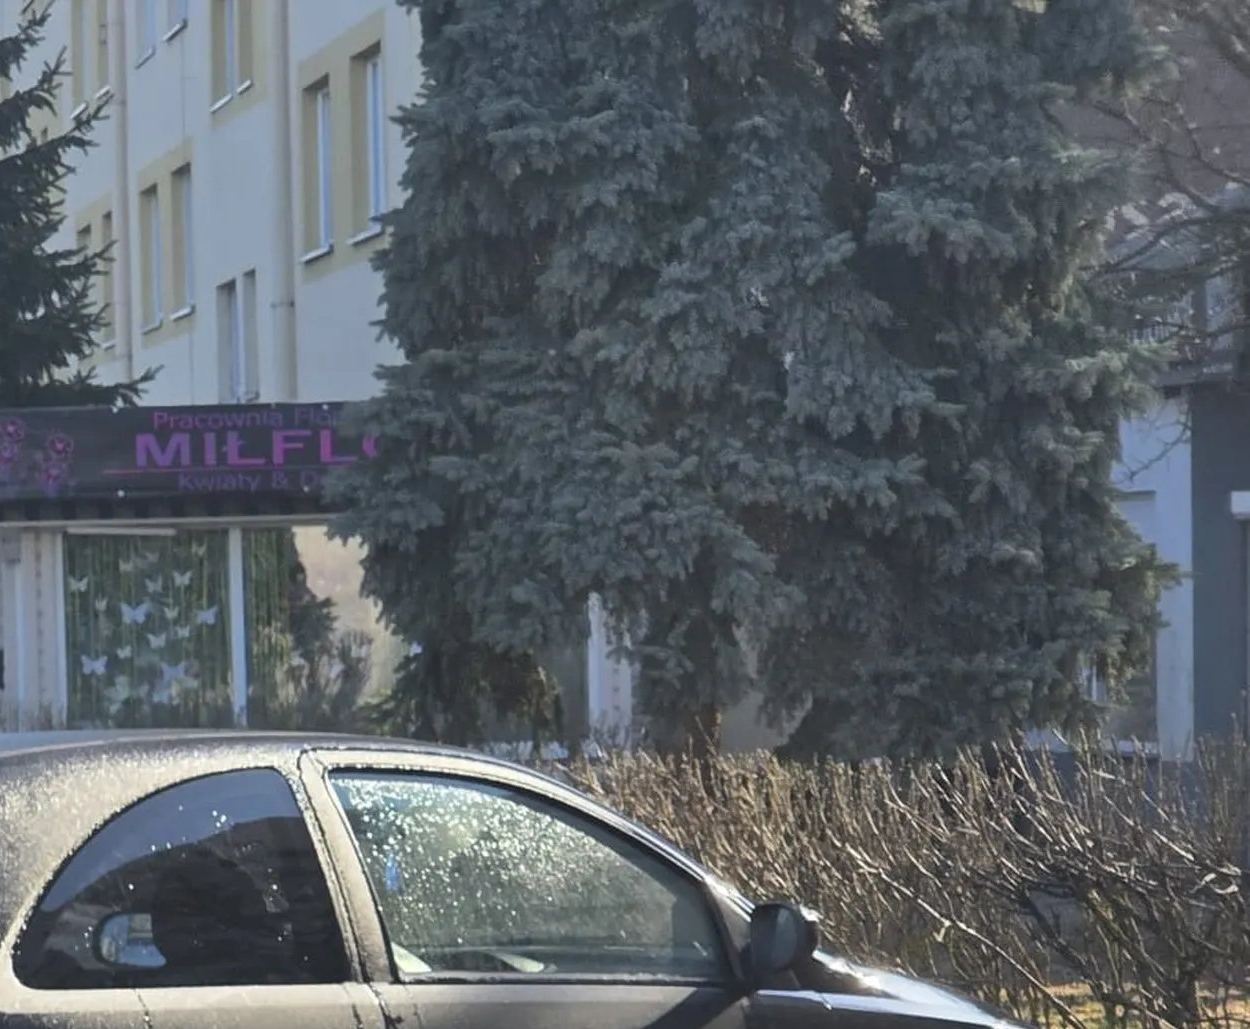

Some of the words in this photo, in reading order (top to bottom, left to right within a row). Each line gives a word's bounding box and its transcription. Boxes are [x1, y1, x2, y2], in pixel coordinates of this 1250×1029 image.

[153, 411, 283, 430] Pracownia
[178, 472, 260, 493] Kwiaty
[272, 470, 288, 489] &
